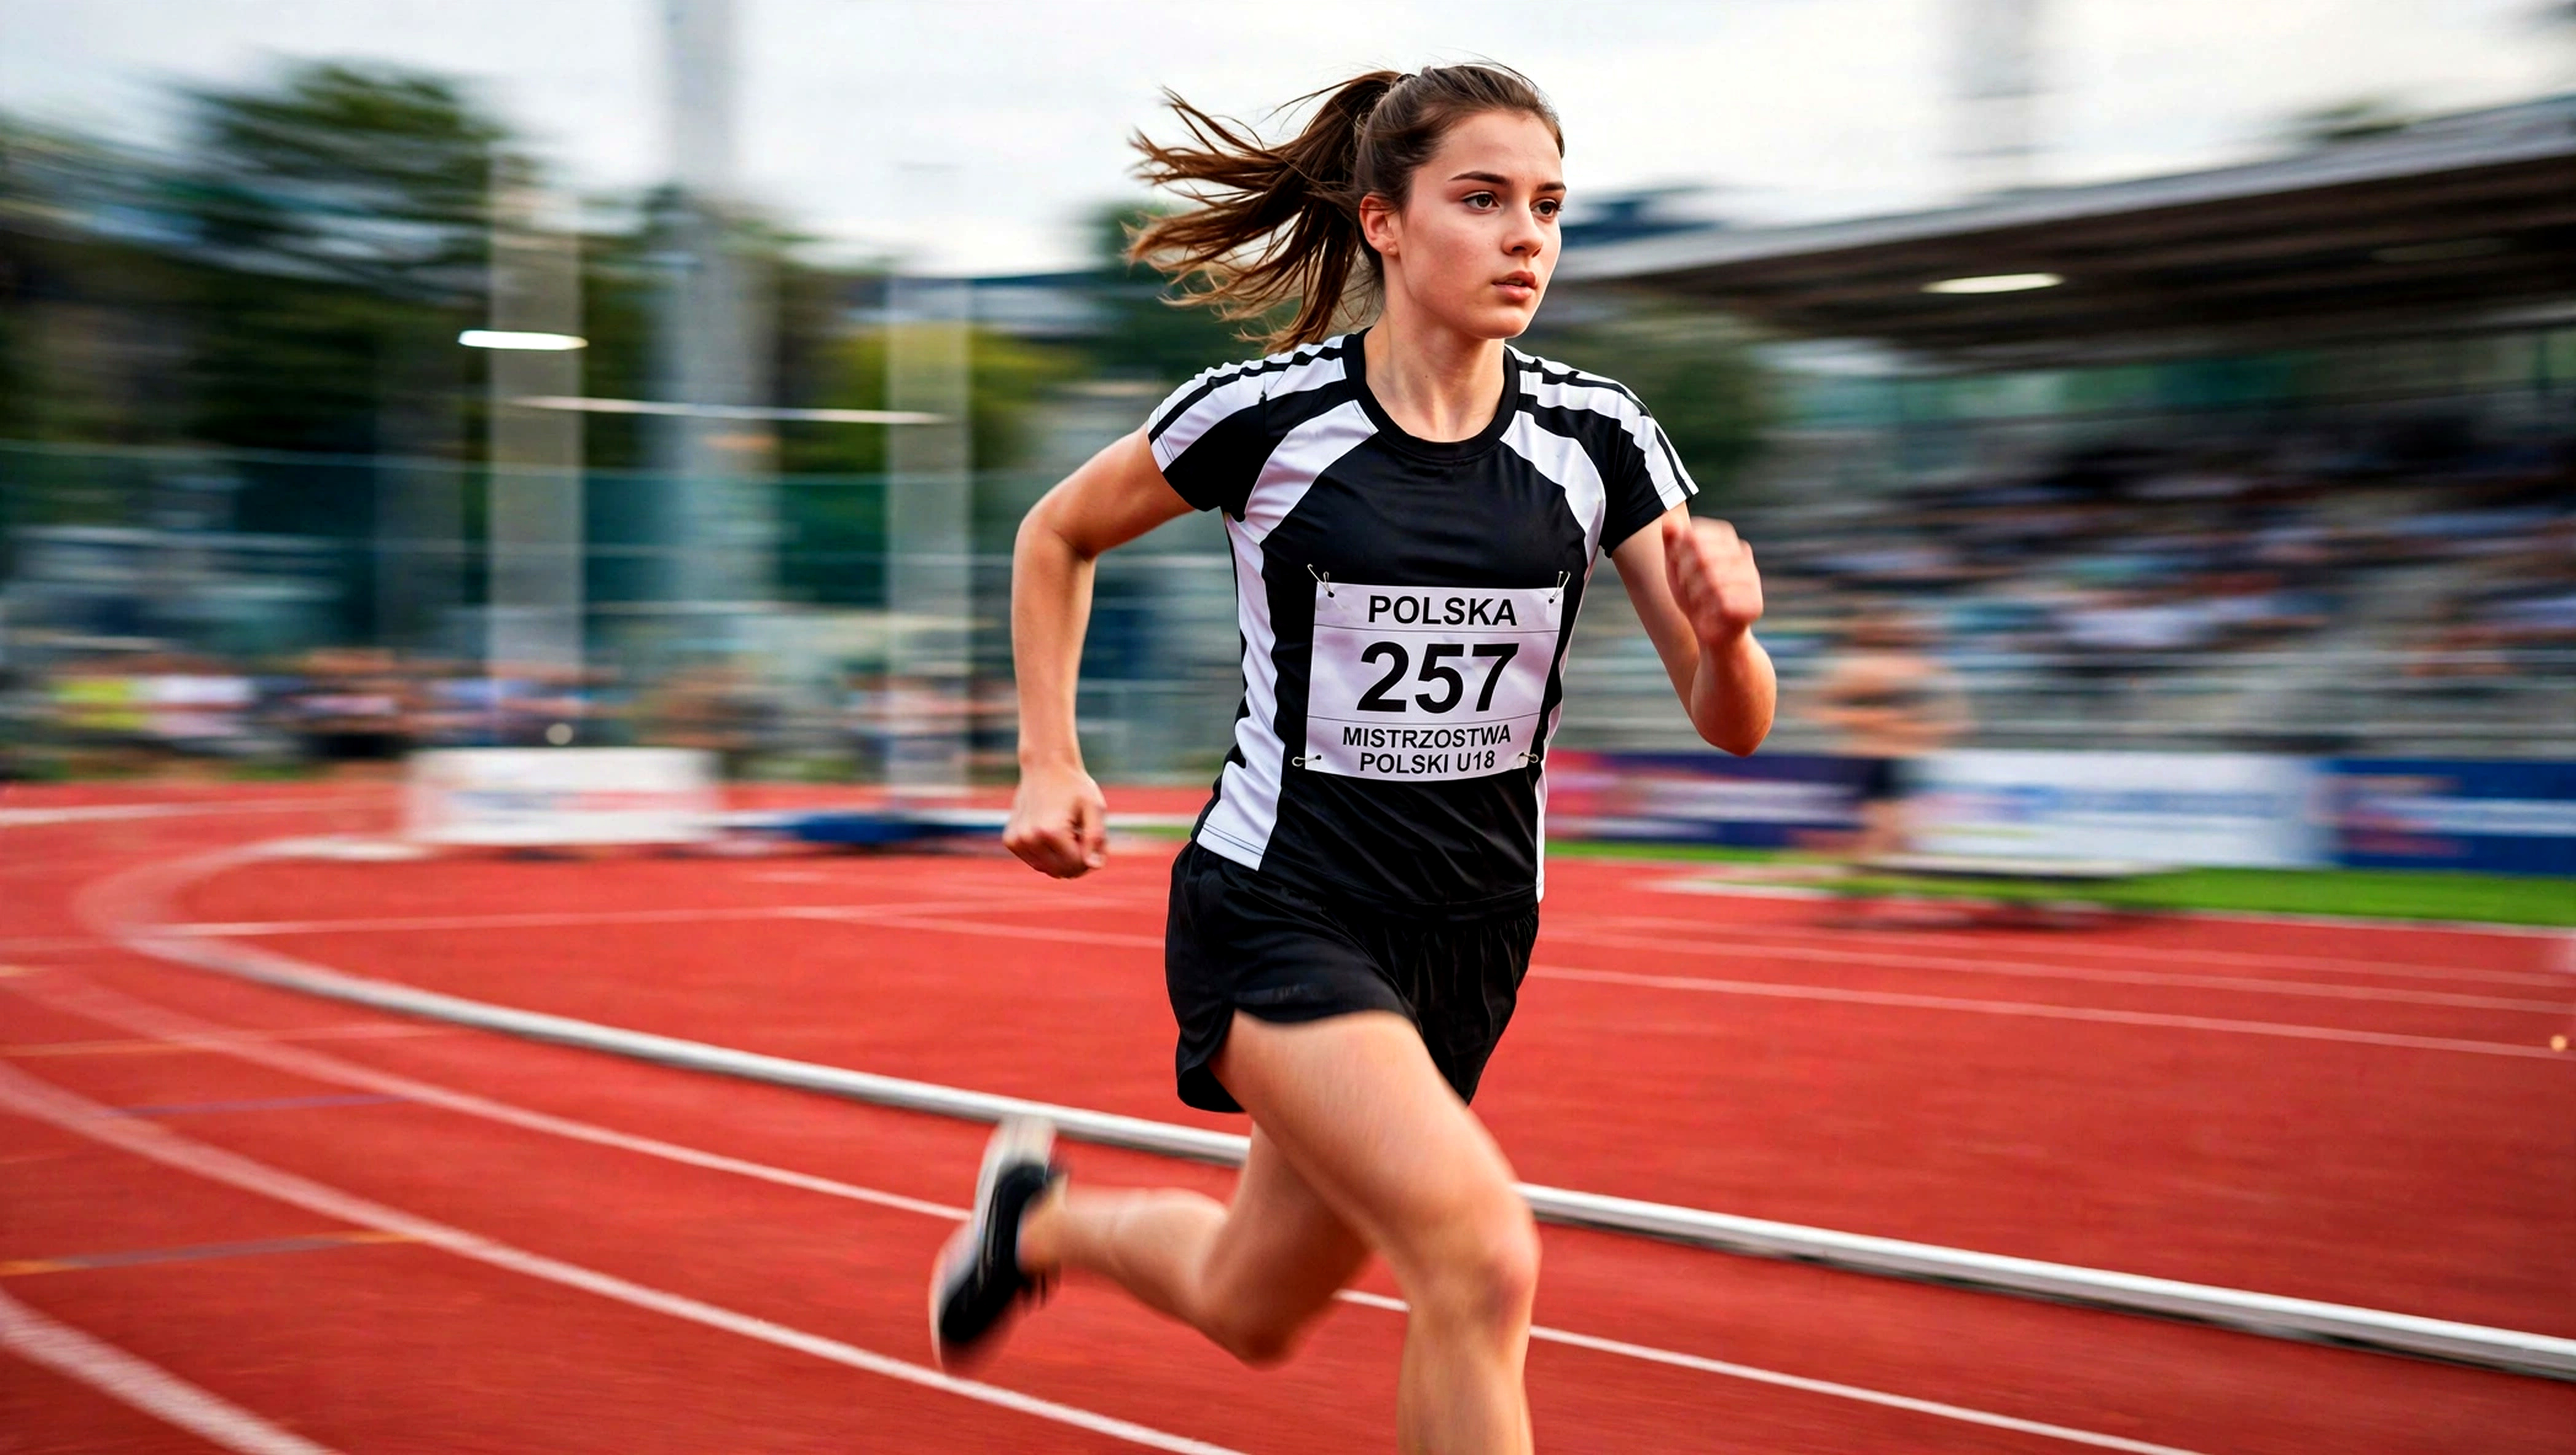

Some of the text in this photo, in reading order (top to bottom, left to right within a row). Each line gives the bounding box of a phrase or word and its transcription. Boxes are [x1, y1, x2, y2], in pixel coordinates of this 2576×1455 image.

[1368, 595, 1517, 626] POLSKA
[1356, 641, 1520, 713] 257
[1343, 724, 1511, 748] MISTRZOSTWA
[1359, 750, 1495, 774] POLSKI U18
